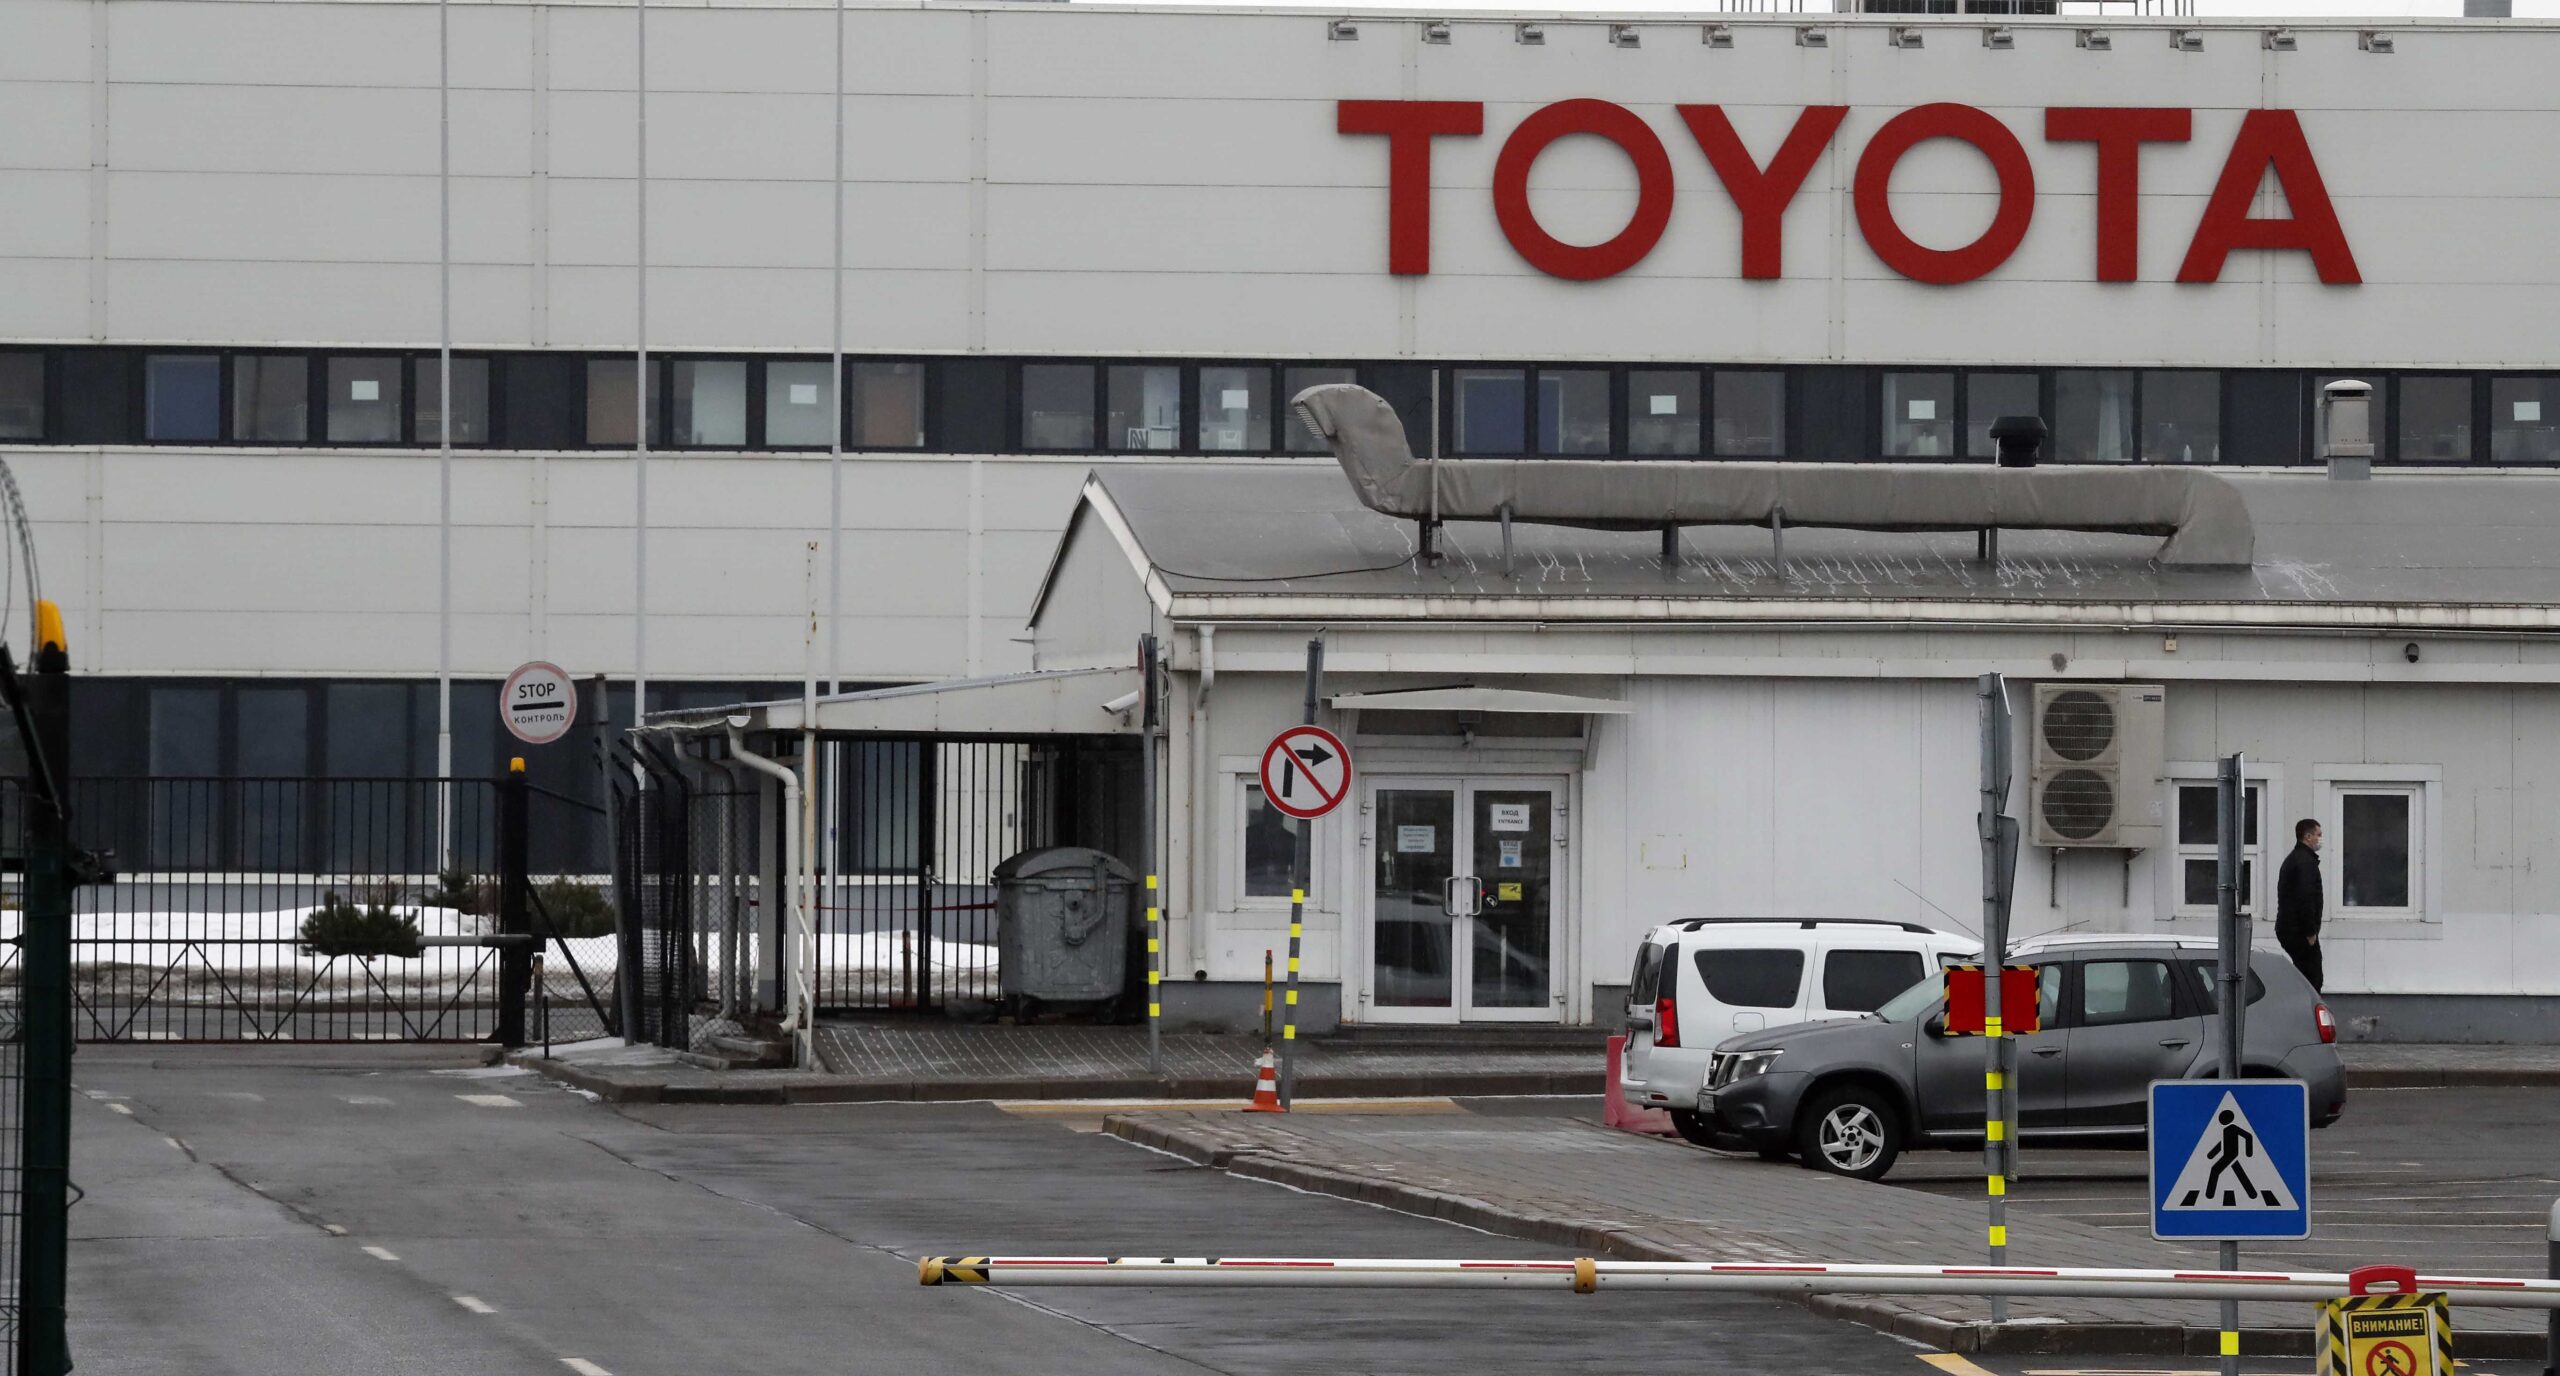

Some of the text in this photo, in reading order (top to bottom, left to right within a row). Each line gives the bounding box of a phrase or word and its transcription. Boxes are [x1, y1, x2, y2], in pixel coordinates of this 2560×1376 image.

[1337, 98, 2363, 285] TOYOTA
[518, 682, 556, 699] STOP
[514, 713, 565, 724] КОНТРОЛЬ
[2352, 1318, 2424, 1334] ВНИМАНИЕ!
